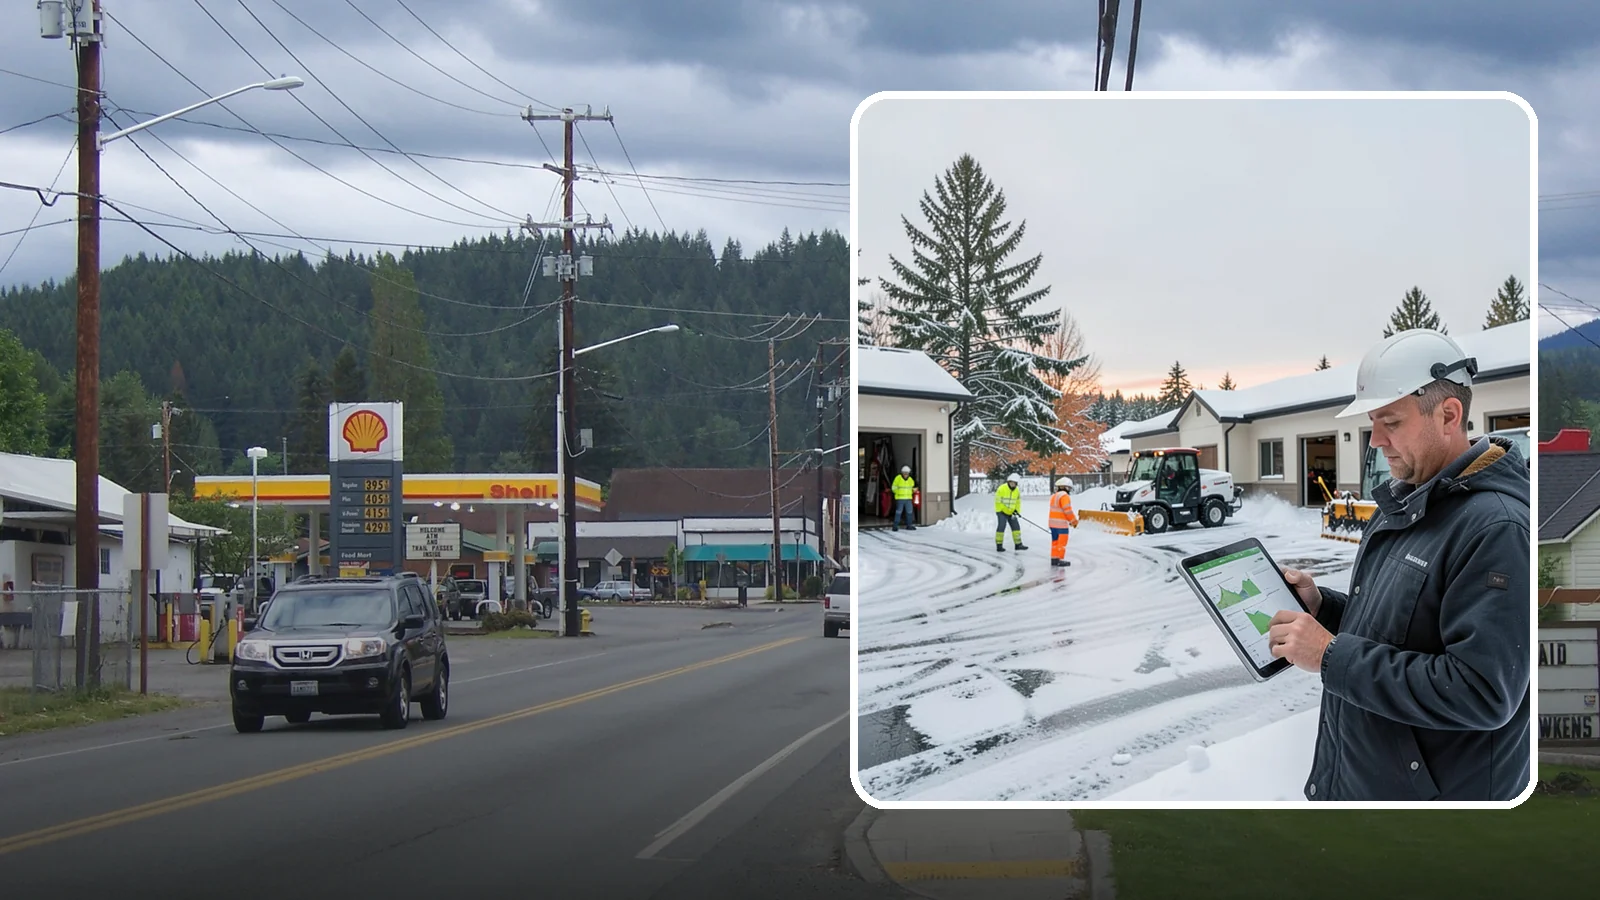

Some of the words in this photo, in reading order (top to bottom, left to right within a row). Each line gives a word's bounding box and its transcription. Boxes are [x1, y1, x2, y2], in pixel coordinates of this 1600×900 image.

[366, 480, 383, 490] 395
[490, 484, 548, 498] Shell
[366, 494, 383, 504] 405
[366, 508, 383, 517] 415
[366, 522, 383, 532] 429
